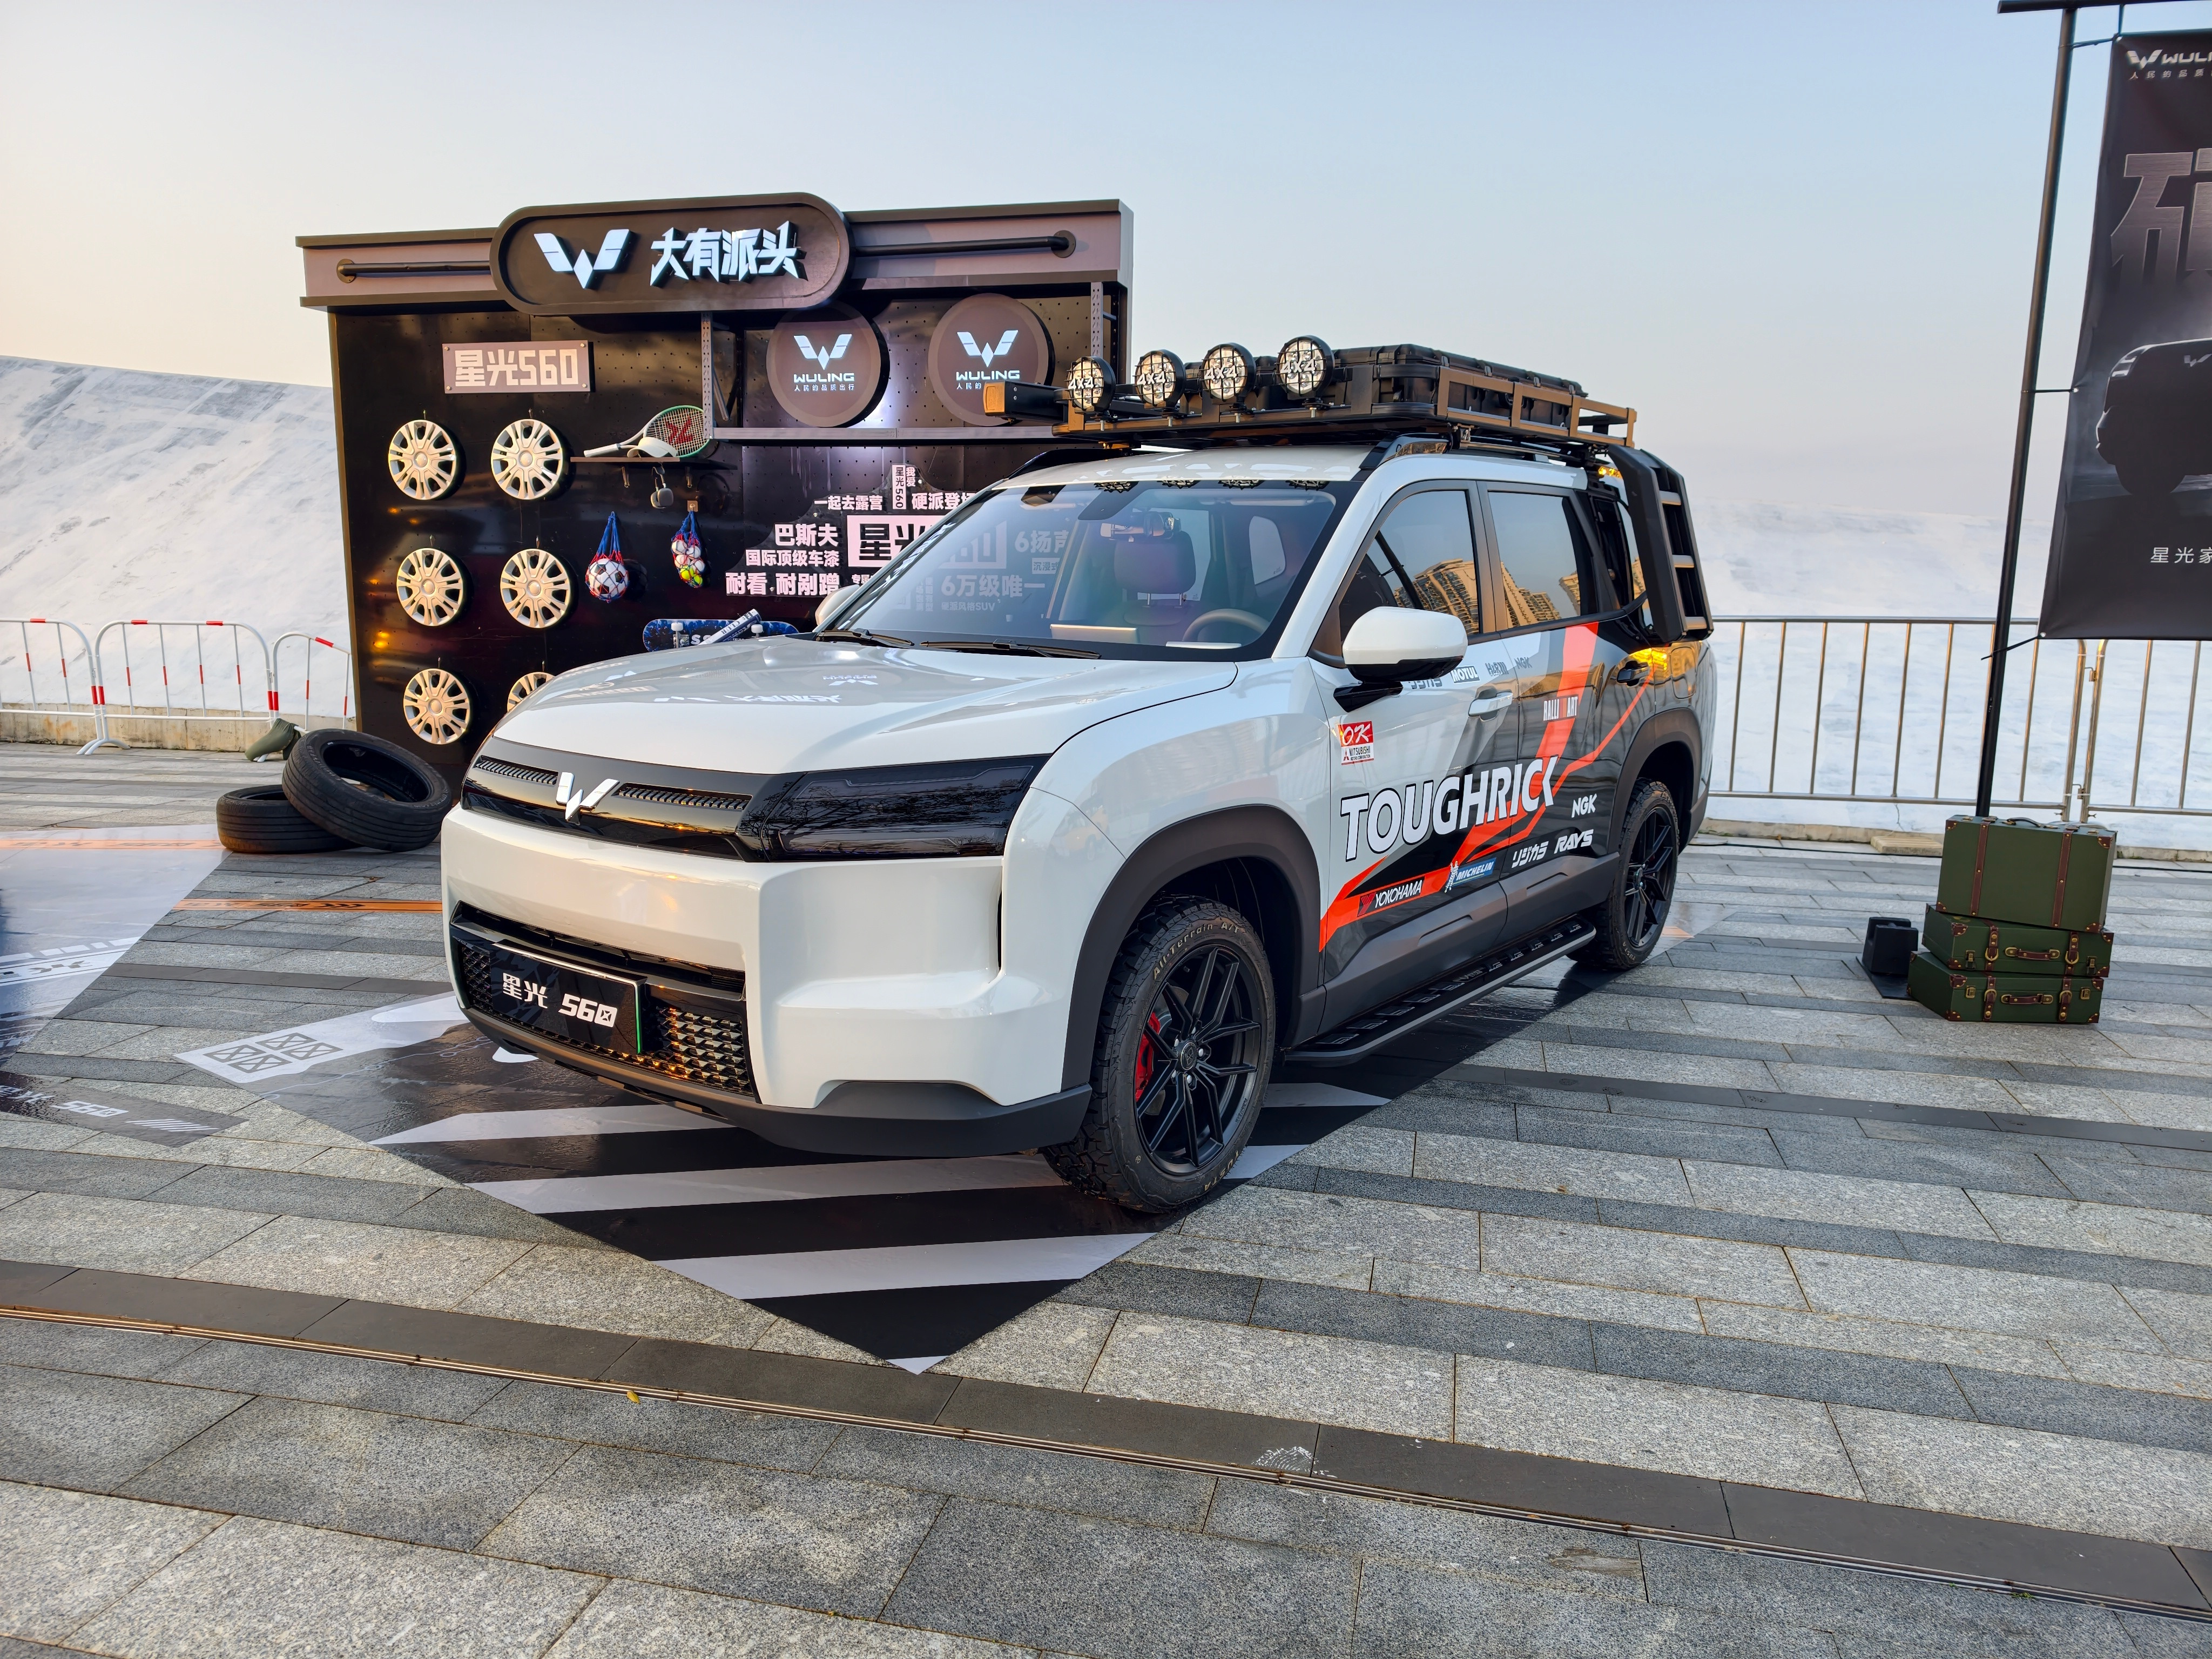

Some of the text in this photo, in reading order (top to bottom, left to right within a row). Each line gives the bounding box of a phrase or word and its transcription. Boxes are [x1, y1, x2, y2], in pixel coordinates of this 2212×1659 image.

[650, 220, 802, 286] 大有派头
[455, 348, 579, 387] 星光560
[793, 373, 855, 383] WULING
[956, 370, 1020, 380] WULING
[794, 383, 855, 392] 人民的品质出行
[895, 467, 905, 508] 星光560
[906, 467, 916, 487] 我爱
[814, 495, 883, 511] 一起去露营
[774, 524, 839, 547] 巴斯夫
[745, 550, 839, 567] 国际顶级车漆
[725, 572, 840, 596] 耐看 耐剐蹭
[852, 574, 873, 584] 专属
[941, 575, 1046, 598] 6万级唯一
[941, 602, 996, 611] 硬派风格SUV
[1514, 657, 1533, 669] NGK
[1451, 666, 1478, 682] MOTUL
[1342, 724, 1371, 745] OK
[1340, 754, 1559, 862] TOUGHRICK
[1572, 793, 1597, 818] NGK
[1554, 829, 1594, 854] RAYS
[1512, 841, 1549, 868] リジカラ
[1456, 861, 1494, 881] MICHELIN
[1374, 879, 1423, 908] YOKOHAMA
[502, 972, 618, 1028] 星光 560
[49, 1101, 129, 1117] 560
